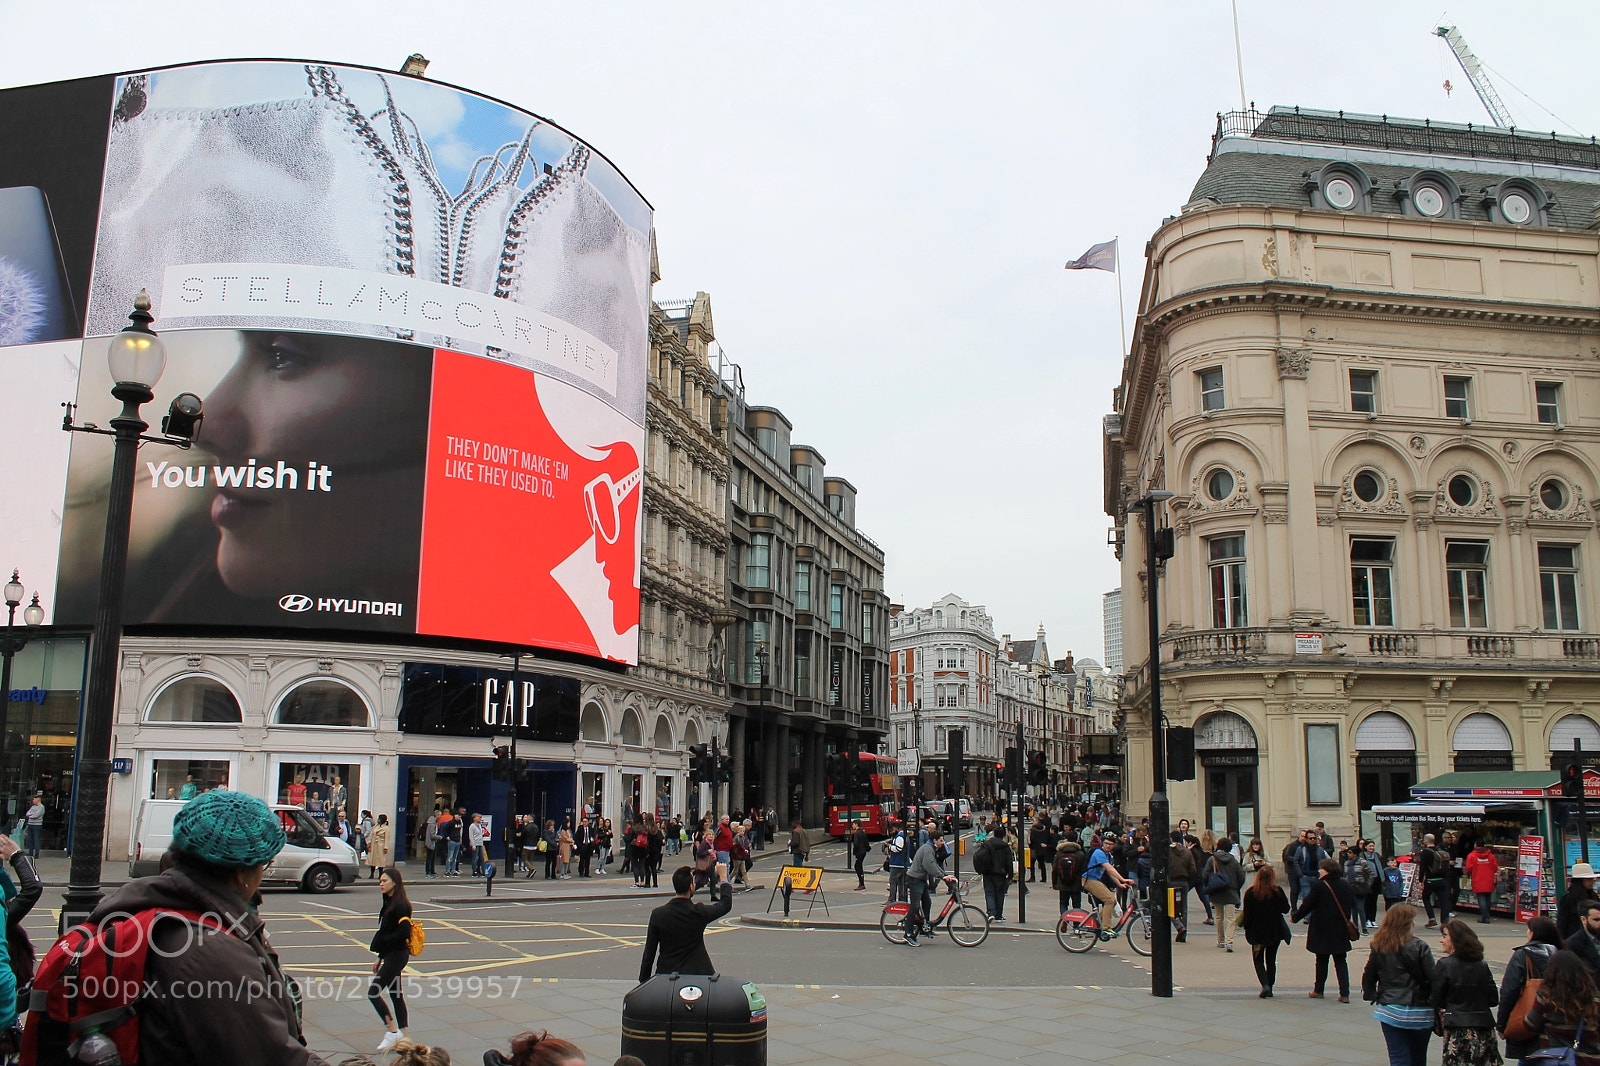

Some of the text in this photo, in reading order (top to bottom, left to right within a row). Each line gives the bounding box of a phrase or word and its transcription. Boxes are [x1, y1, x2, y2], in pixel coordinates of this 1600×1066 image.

[146, 458, 332, 492] You wish it
[446, 436, 569, 481] THEY DON'T MAKE 'EM
[445, 459, 555, 499] LIKE THEY USED TO.
[317, 598, 403, 617] HYUNDAI
[482, 677, 535, 727] GAP
[784, 870, 807, 878] Diverted
